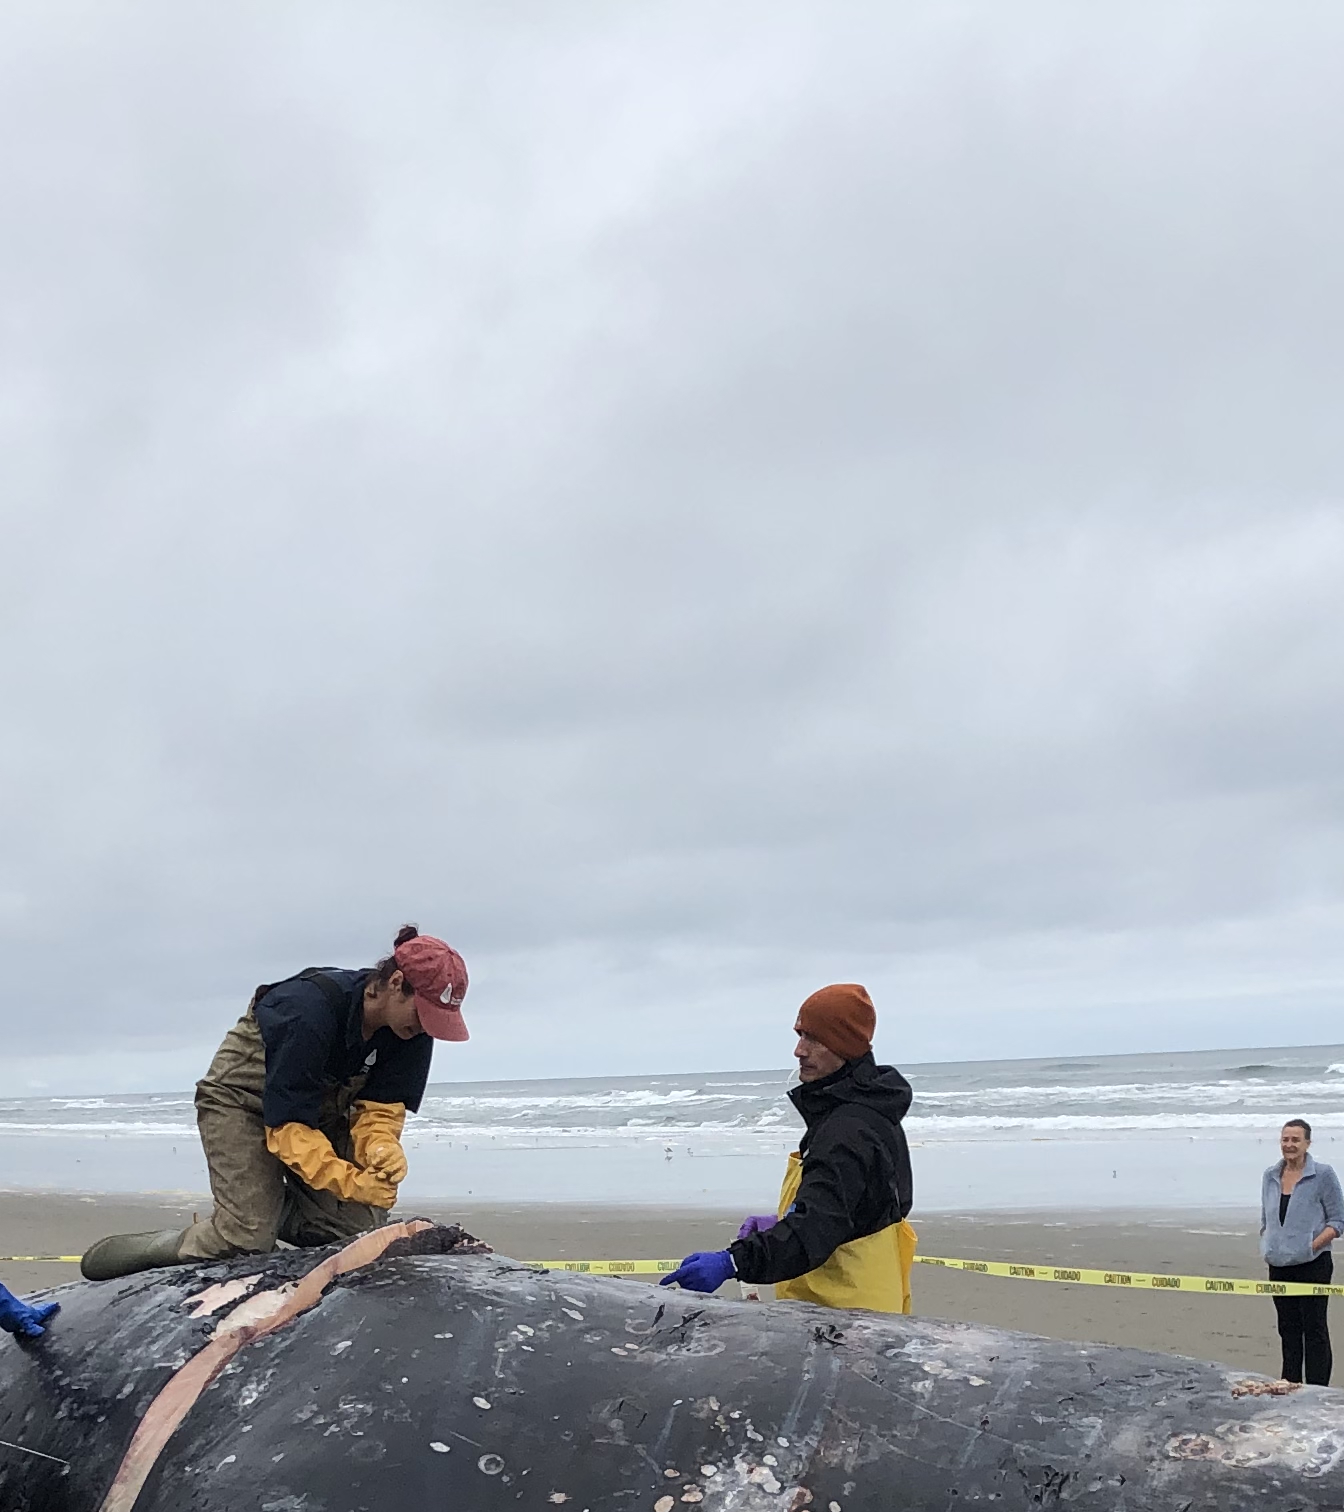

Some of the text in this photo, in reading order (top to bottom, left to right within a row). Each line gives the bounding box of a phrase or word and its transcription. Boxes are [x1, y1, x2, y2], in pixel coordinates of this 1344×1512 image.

[1009, 1265, 1080, 1281] CAUTION CUIDADO
[1104, 1273, 1181, 1288] CAUTION CUIDADO
[1205, 1279, 1286, 1294] CAUTION CUIDADO
